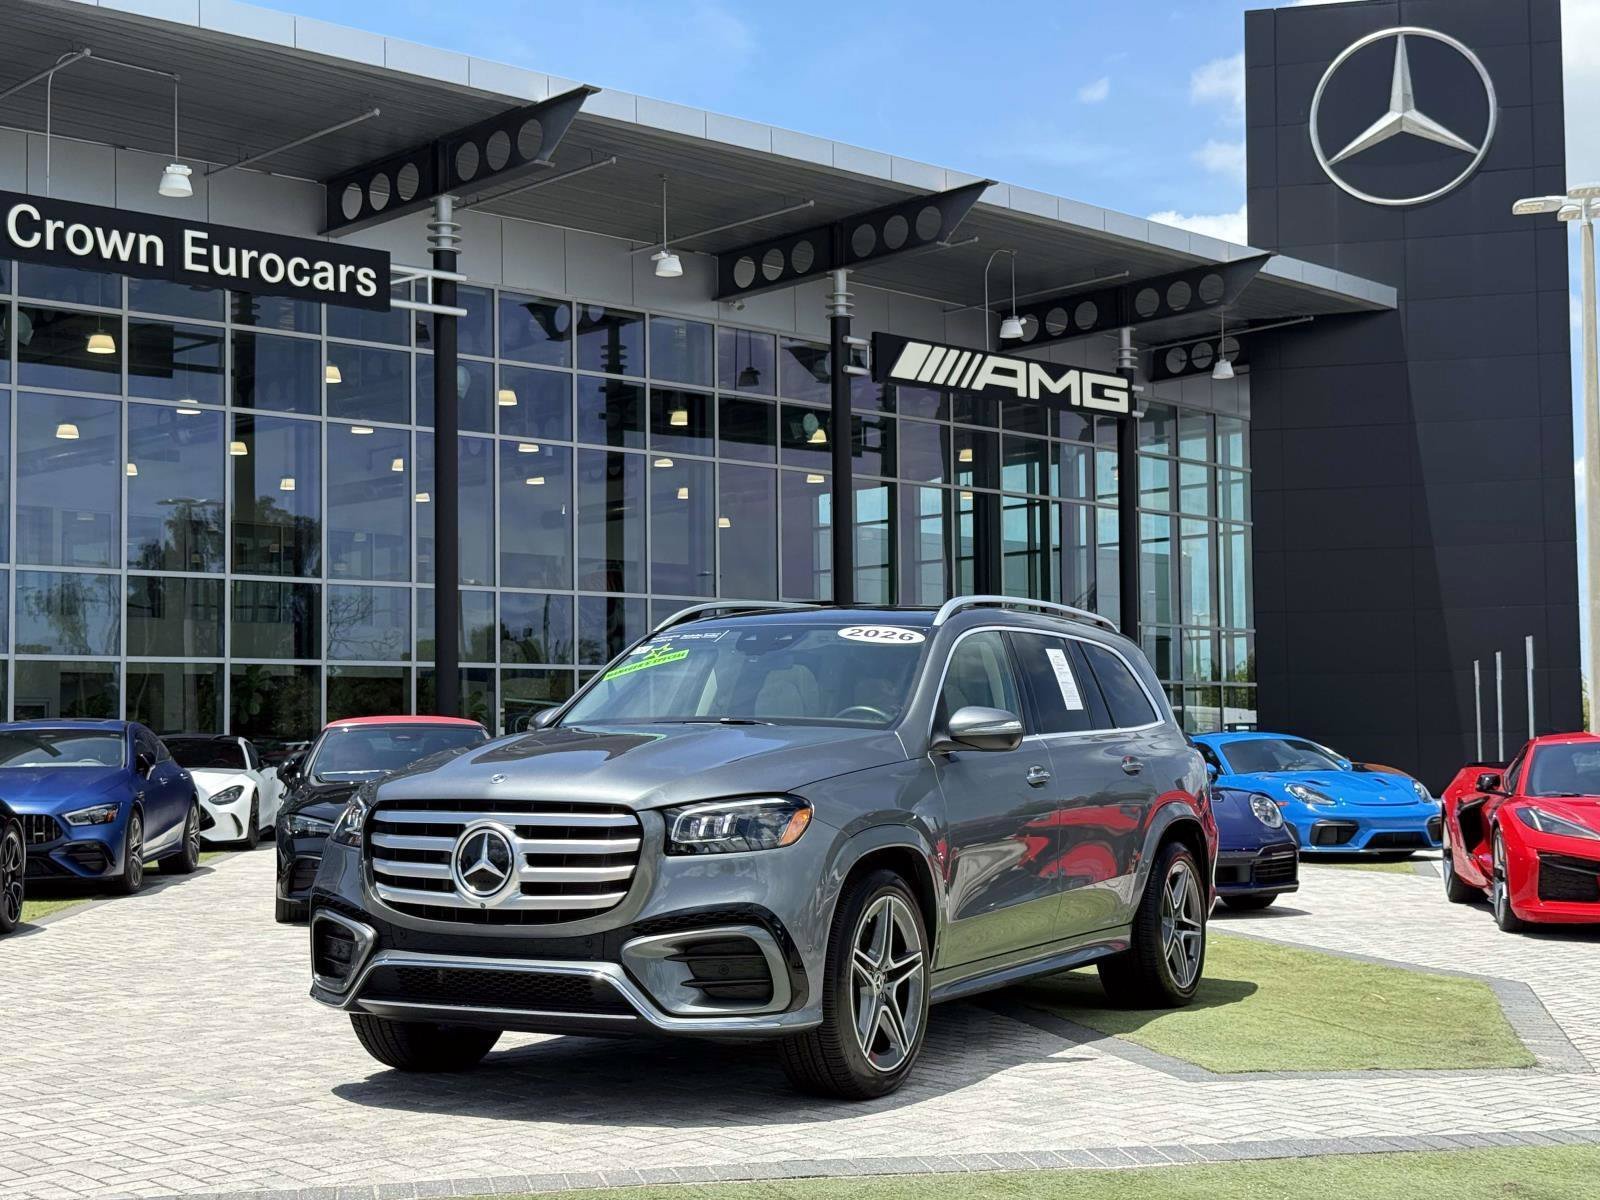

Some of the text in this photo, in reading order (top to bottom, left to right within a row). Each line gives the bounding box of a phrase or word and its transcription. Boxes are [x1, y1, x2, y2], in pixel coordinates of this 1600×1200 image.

[7, 203, 377, 297] Crown Eurocars
[970, 354, 1129, 413] AMG
[847, 628, 914, 641] 2026
